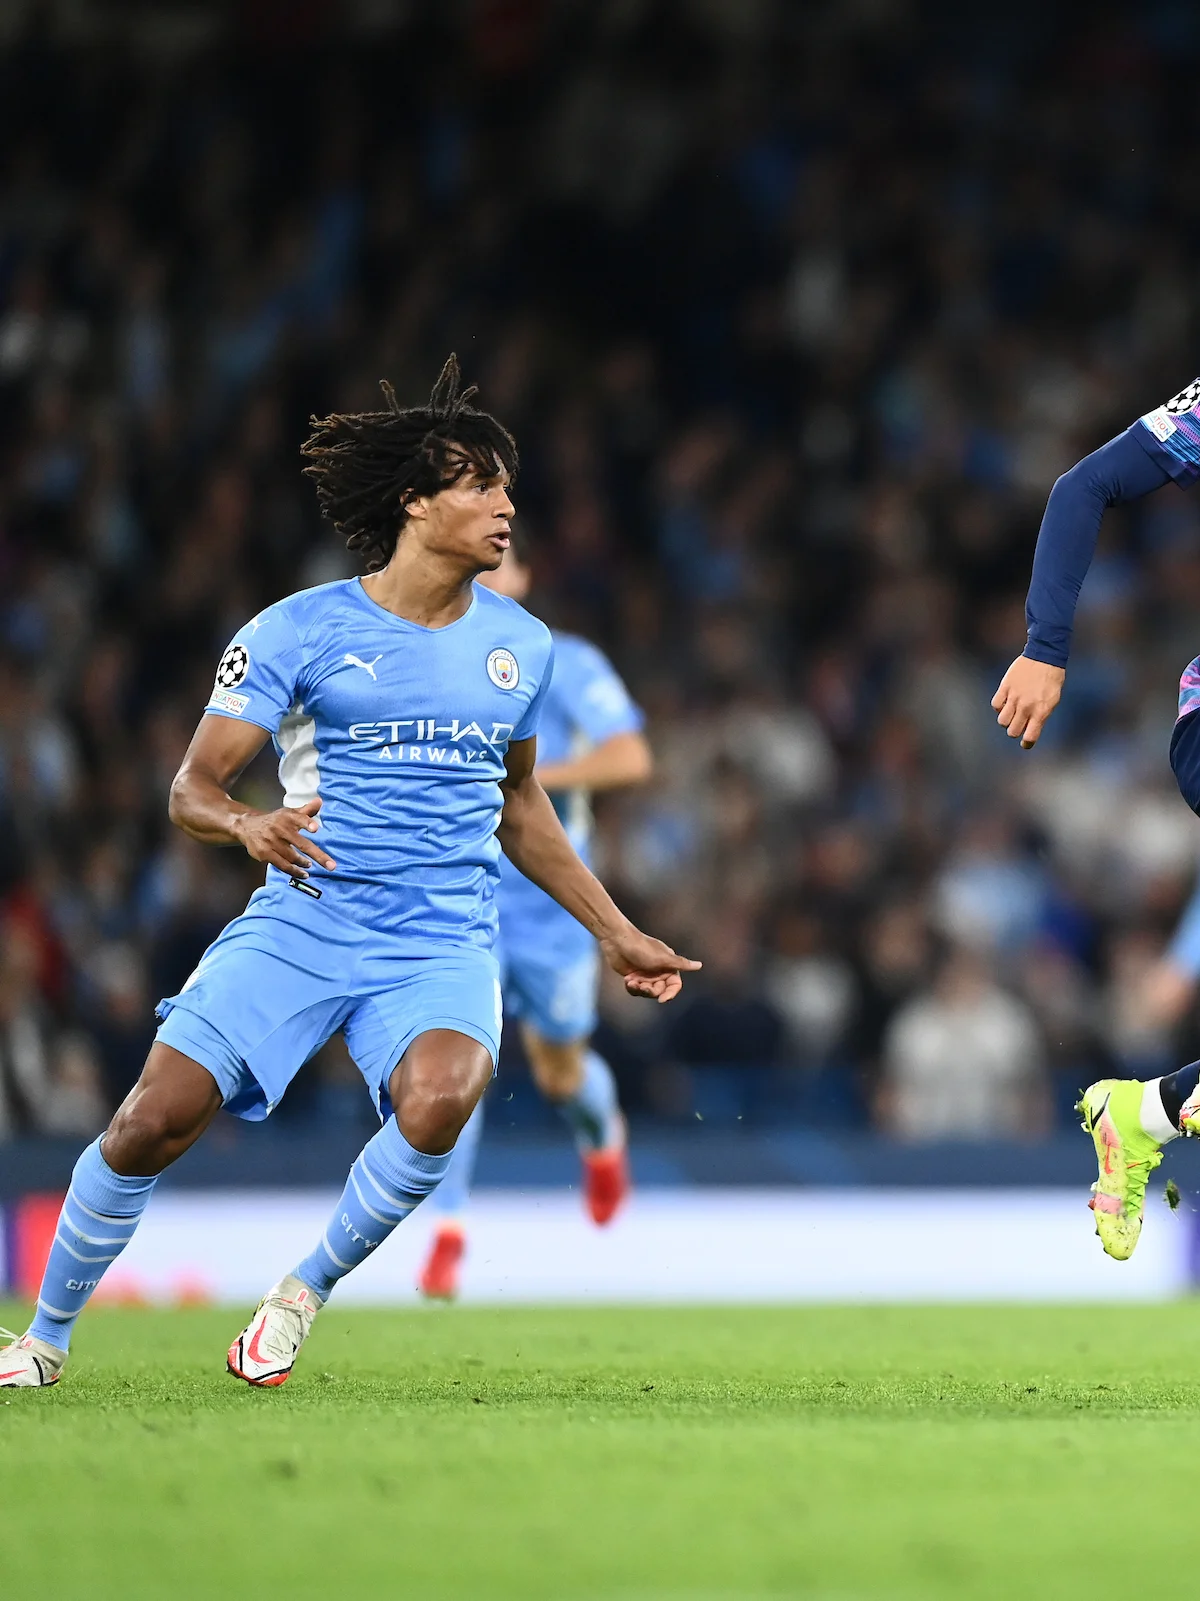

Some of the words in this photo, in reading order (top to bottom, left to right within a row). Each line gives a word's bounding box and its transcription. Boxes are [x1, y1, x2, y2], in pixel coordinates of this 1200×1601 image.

[489, 650, 517, 667] MANCHESTER
[349, 719, 515, 744] ETIHAD
[378, 745, 488, 764] AIRWAYS
